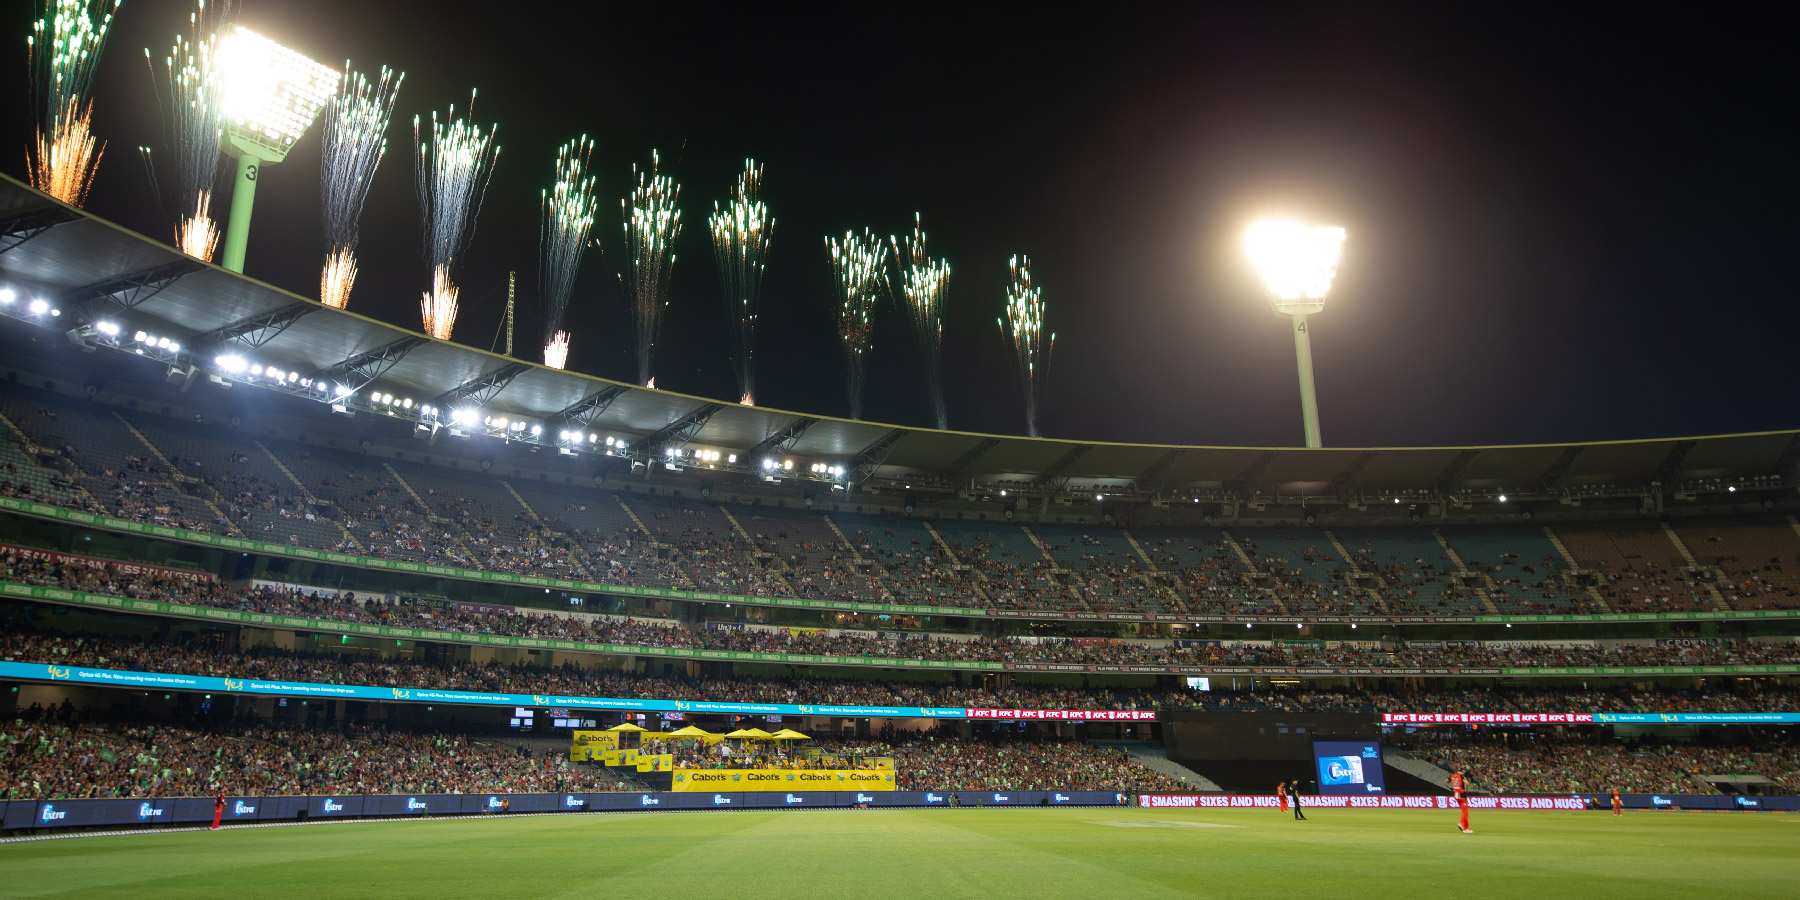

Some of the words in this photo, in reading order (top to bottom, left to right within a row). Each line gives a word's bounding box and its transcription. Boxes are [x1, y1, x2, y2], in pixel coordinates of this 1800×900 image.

[246, 164, 257, 181] 3
[1298, 322, 1306, 333] 4
[109, 598, 122, 606] STARS
[228, 611, 241, 620] STARS
[48, 665, 70, 680] yes
[225, 678, 243, 691] yes
[393, 688, 409, 699] yes
[534, 695, 549, 706] yes
[675, 700, 690, 710] yes
[799, 705, 813, 714] yes
[921, 707, 935, 717] yes
[1600, 714, 1616, 722] yes
[1660, 714, 1678, 722] yes
[1332, 766, 1359, 777] Extra
[692, 773, 726, 781] Cabot's
[408, 800, 425, 809] Extra
[1152, 796, 1198, 806] SMASHIN'
[1200, 796, 1229, 807] SIXES
[1231, 796, 1252, 807] AND
[1254, 796, 1281, 807] NUGS
[1299, 796, 1348, 807] SMASHIN'
[1350, 797, 1379, 807] SIXES
[1381, 797, 1403, 807] AND
[1404, 797, 1432, 807] NUGS
[1449, 797, 1498, 808] SASHIN'
[1501, 798, 1528, 808] SIXES
[1531, 798, 1553, 808] AND
[1554, 798, 1583, 809] NUGS
[42, 808, 65, 820] Extra
[140, 806, 162, 816] Extra
[236, 805, 255, 814] Extra
